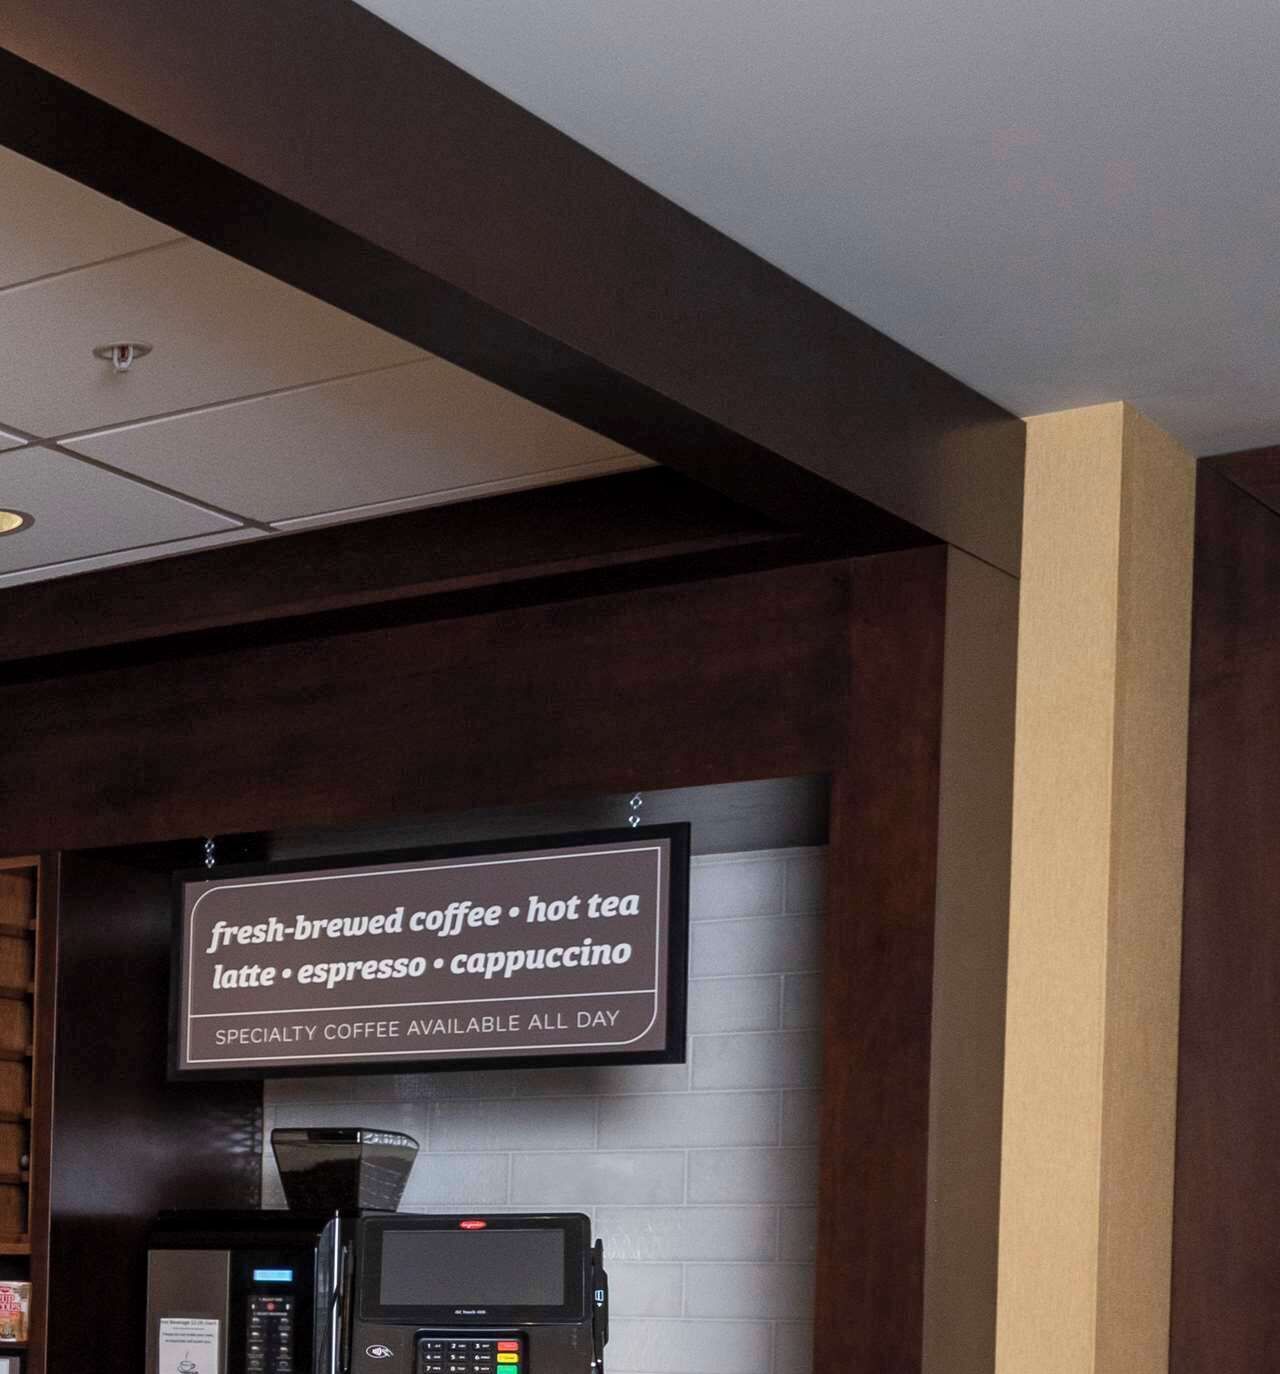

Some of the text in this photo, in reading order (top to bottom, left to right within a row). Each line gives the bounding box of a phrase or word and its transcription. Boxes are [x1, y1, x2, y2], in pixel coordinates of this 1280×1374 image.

[206, 891, 641, 954] fresh-brewed coffee hot tea
[212, 938, 633, 991] latte espresso cappuccino
[215, 1009, 621, 1047] SPECIALTY COFFEE AVAILABLE ALL DAY
